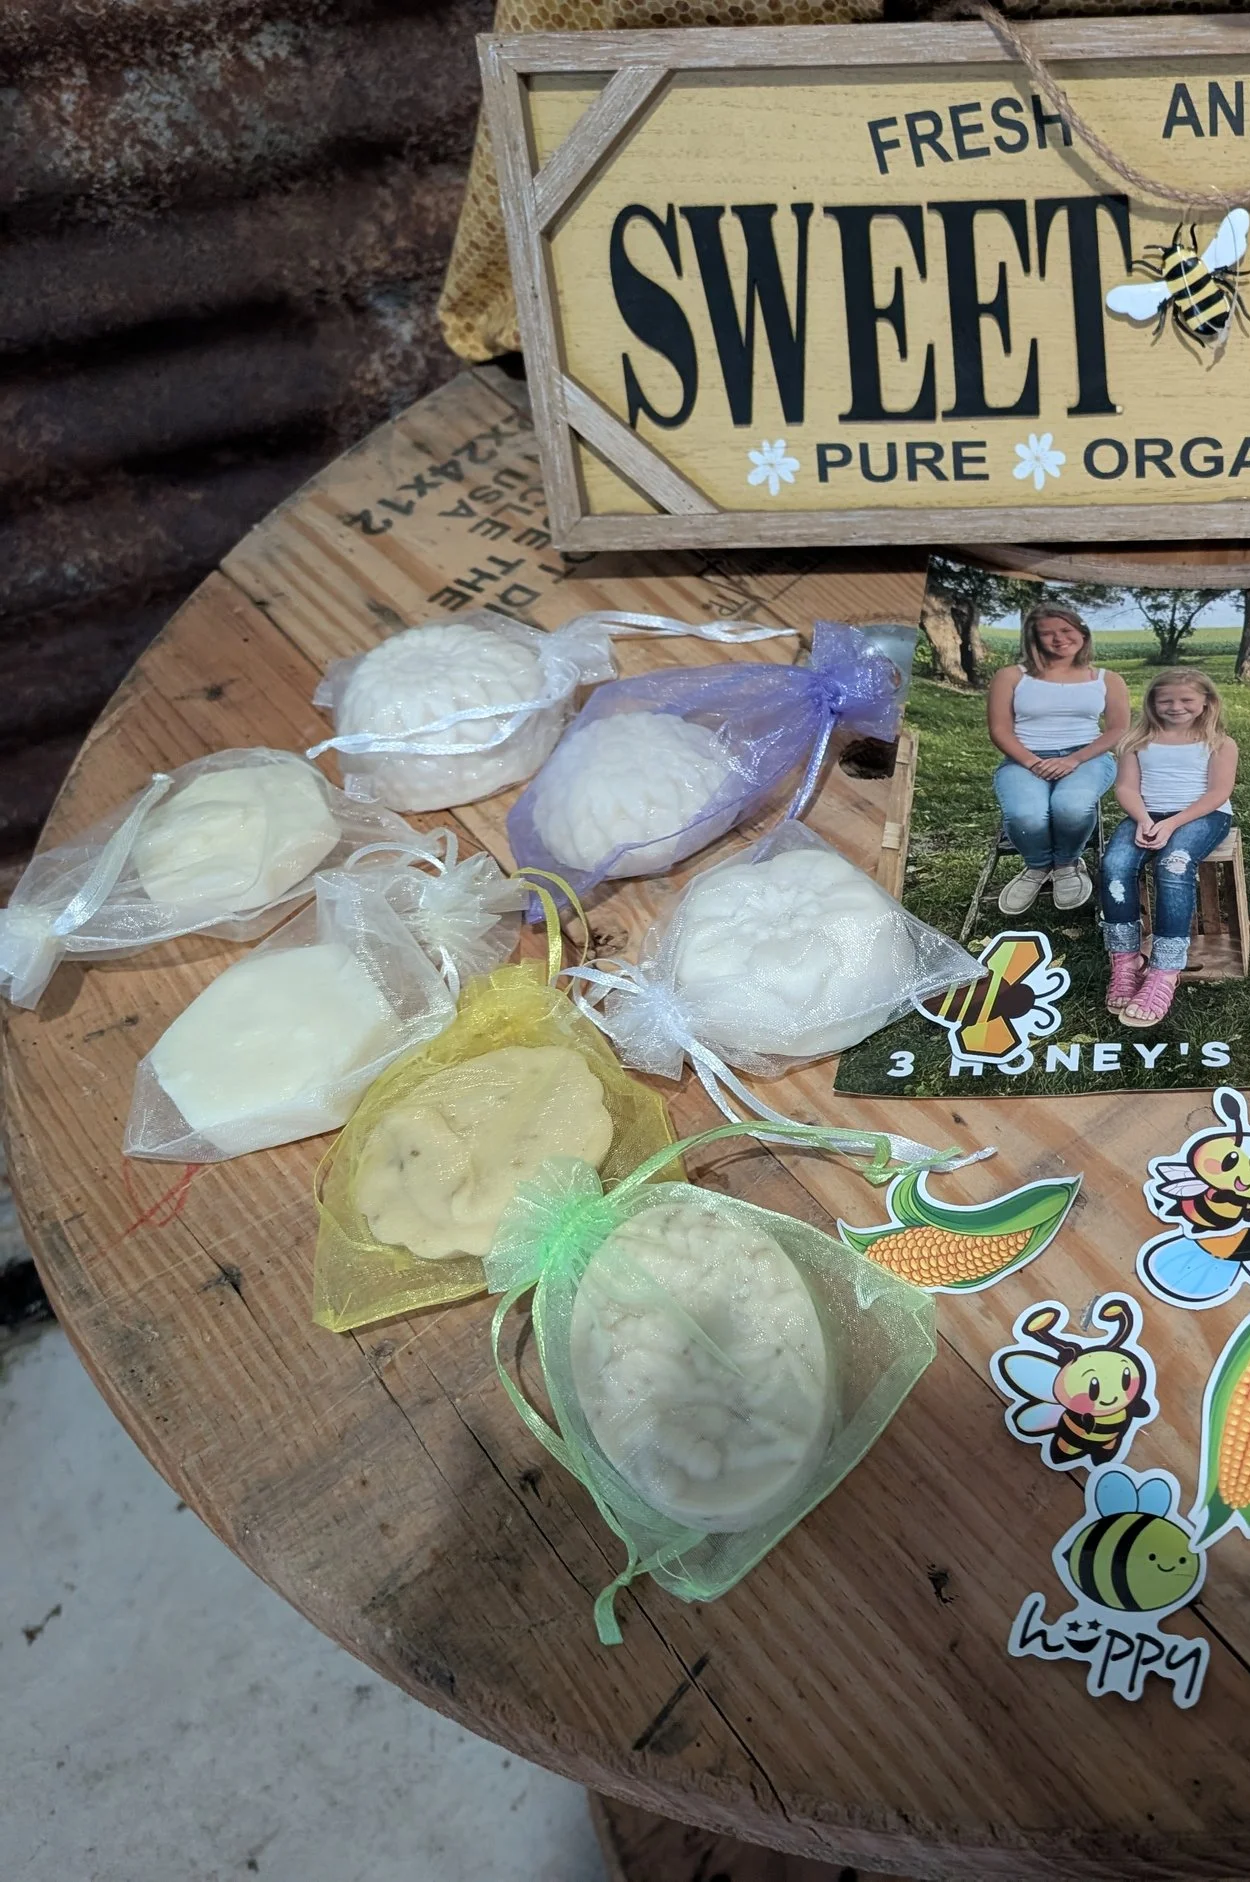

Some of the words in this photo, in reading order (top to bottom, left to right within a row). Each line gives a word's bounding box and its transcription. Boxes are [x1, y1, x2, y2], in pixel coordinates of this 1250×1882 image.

[868, 92, 1073, 175] FRESH
[609, 194, 1134, 428] SWEET
[816, 440, 990, 483] PURE
[438, 467, 529, 519] USA
[427, 555, 526, 611] THE
[886, 1050, 916, 1078] 3
